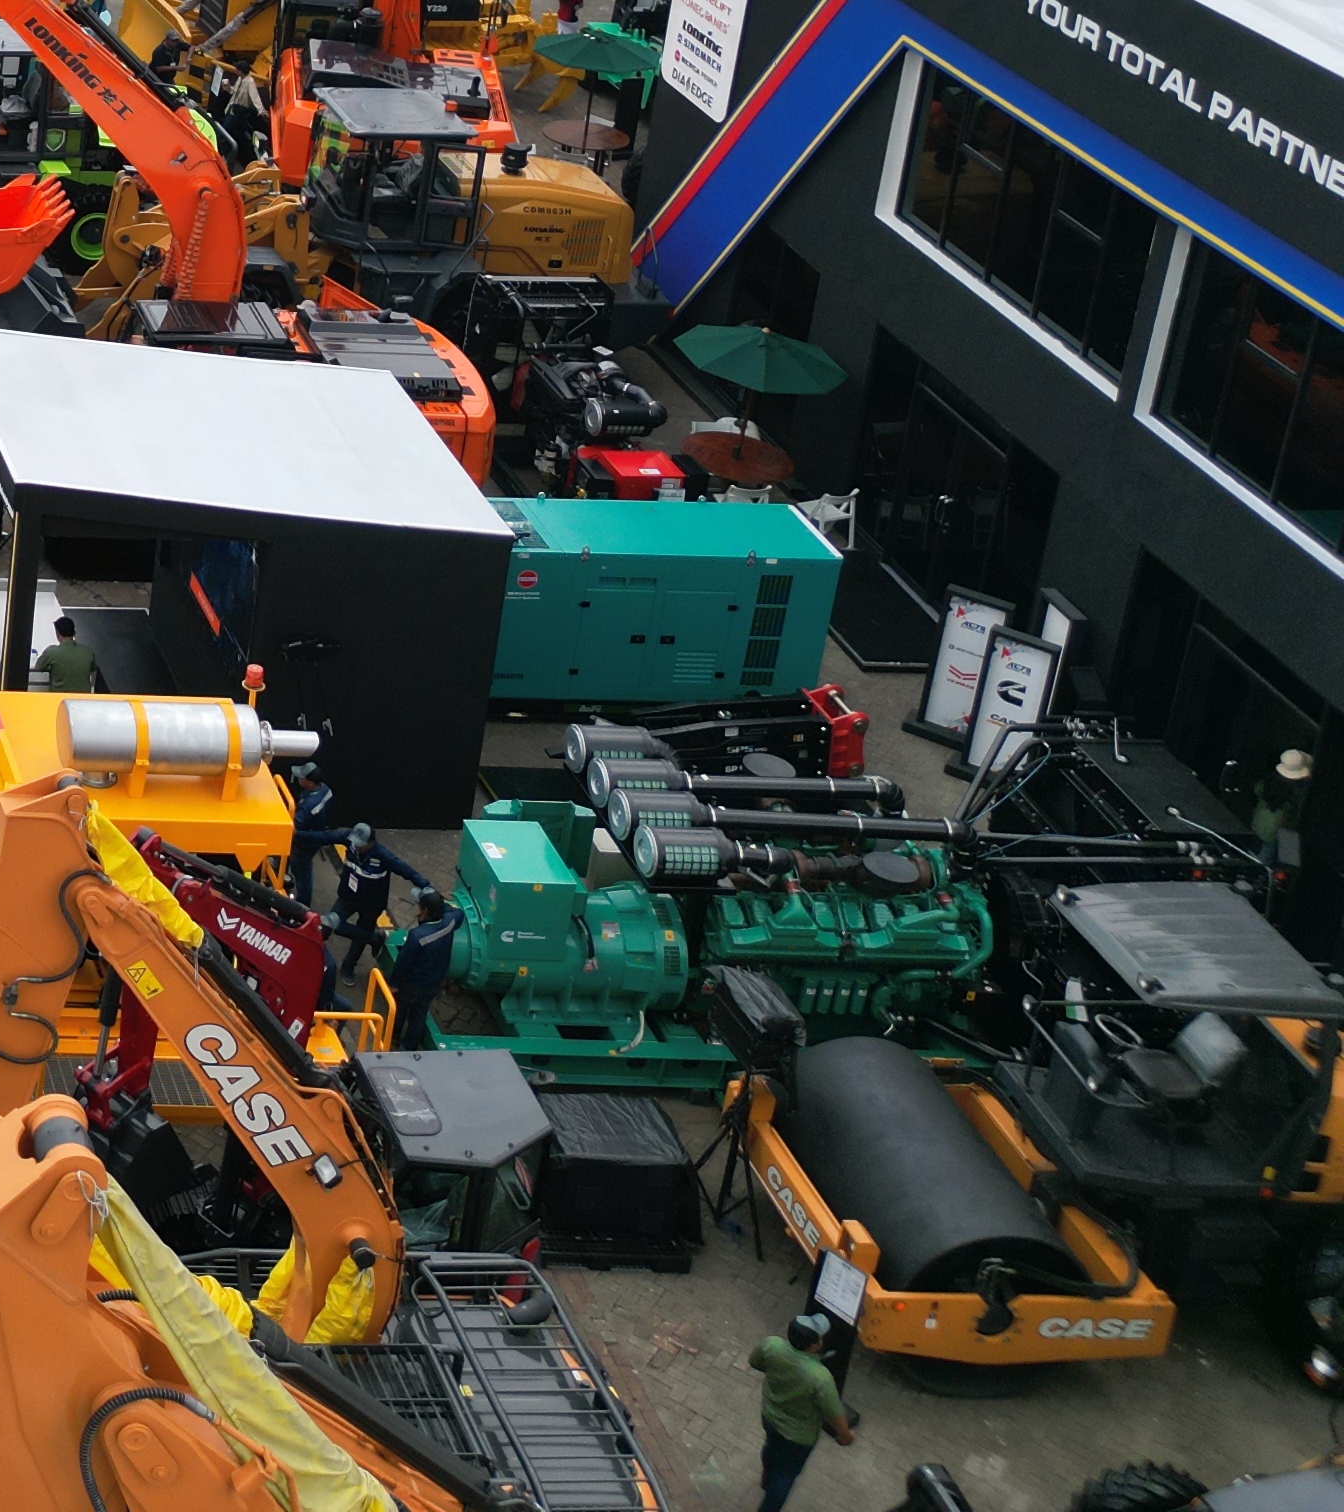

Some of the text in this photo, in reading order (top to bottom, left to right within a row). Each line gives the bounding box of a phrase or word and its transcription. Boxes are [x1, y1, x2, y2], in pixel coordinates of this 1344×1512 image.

[24, 15, 101, 93] LONKING
[682, 20, 722, 58] LONKING
[1106, 33, 1203, 116] TOTAL
[522, 205, 572, 216] CDM863H
[523, 224, 566, 235] LONKING
[235, 920, 292, 966] YANMAR
[184, 1023, 314, 1168] CASE
[765, 1164, 823, 1249] CASE
[1037, 1318, 1155, 1340] CASE
